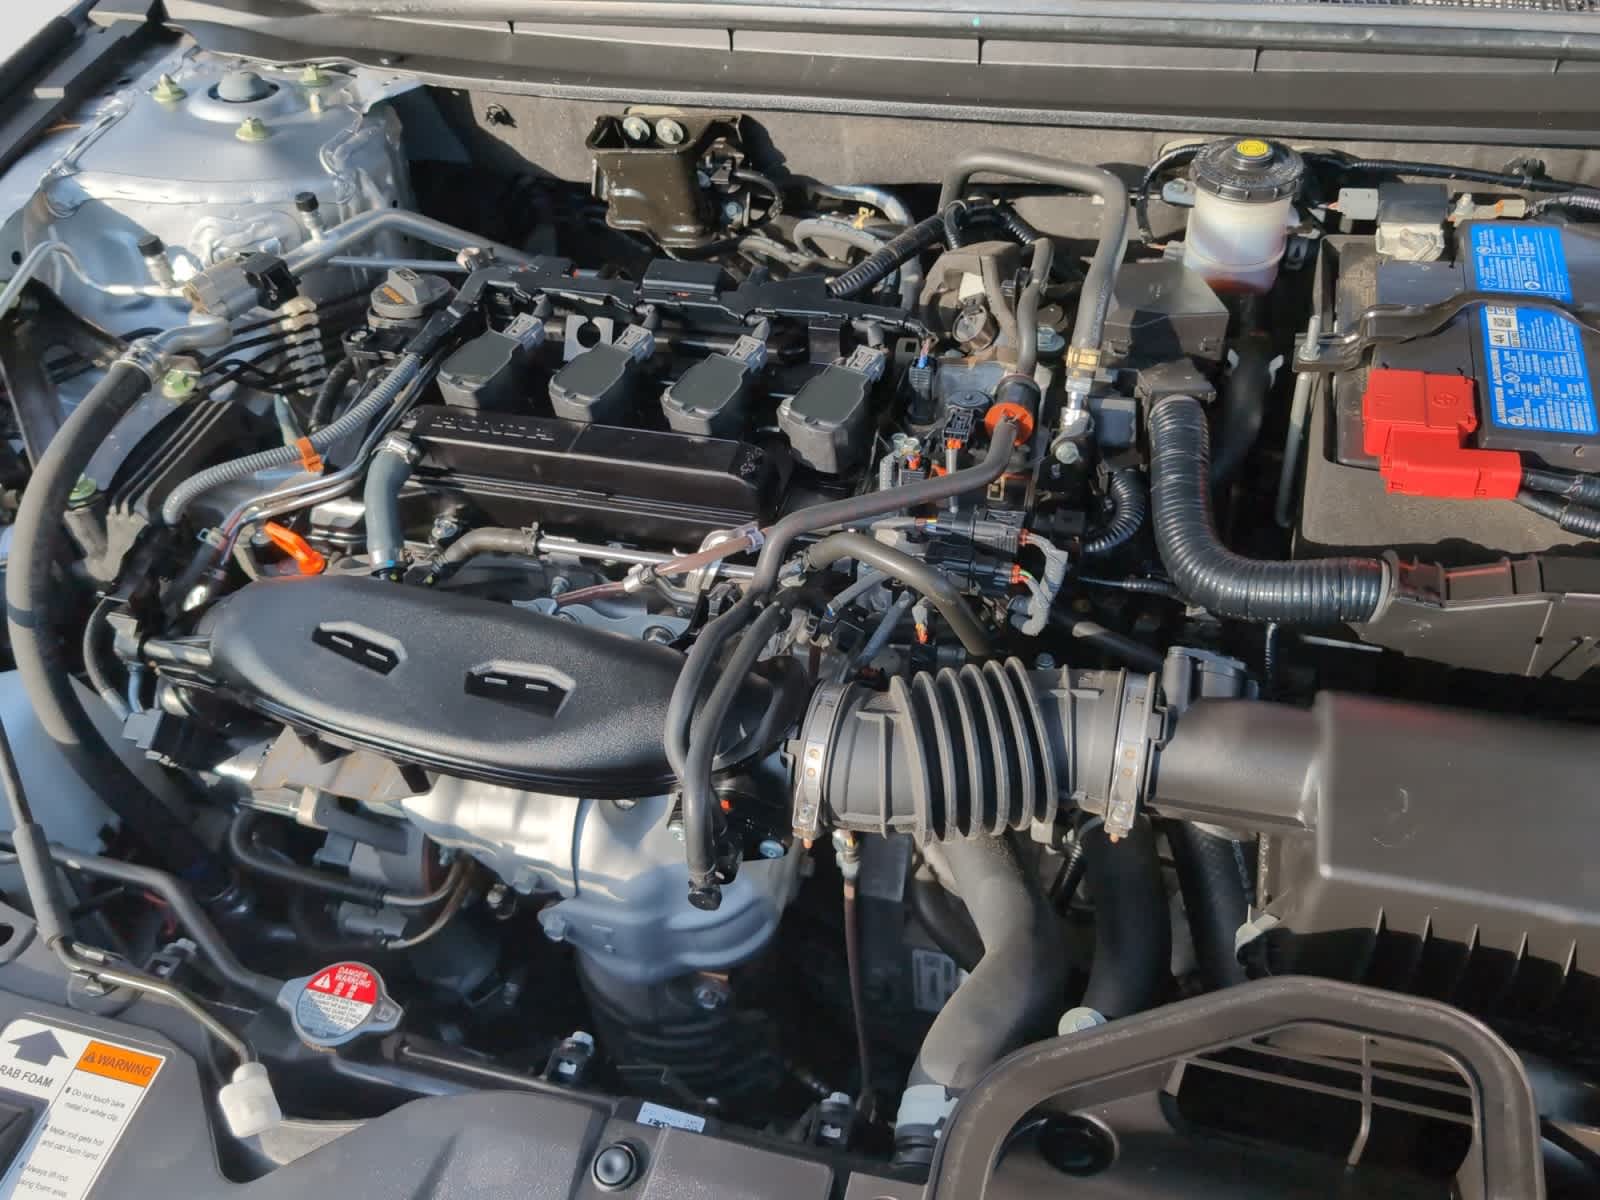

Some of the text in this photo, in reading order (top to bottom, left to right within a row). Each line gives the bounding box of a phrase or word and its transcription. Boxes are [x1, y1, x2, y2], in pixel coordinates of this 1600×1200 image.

[431, 415, 554, 441] HONDA
[96, 1054, 153, 1077] WARNING
[0, 1064, 54, 1088] RAB FOAM
[72, 1088, 82, 1097] Do
[93, 1095, 111, 1104] touch
[90, 1109, 107, 1118] white
[54, 1143, 66, 1151] can
